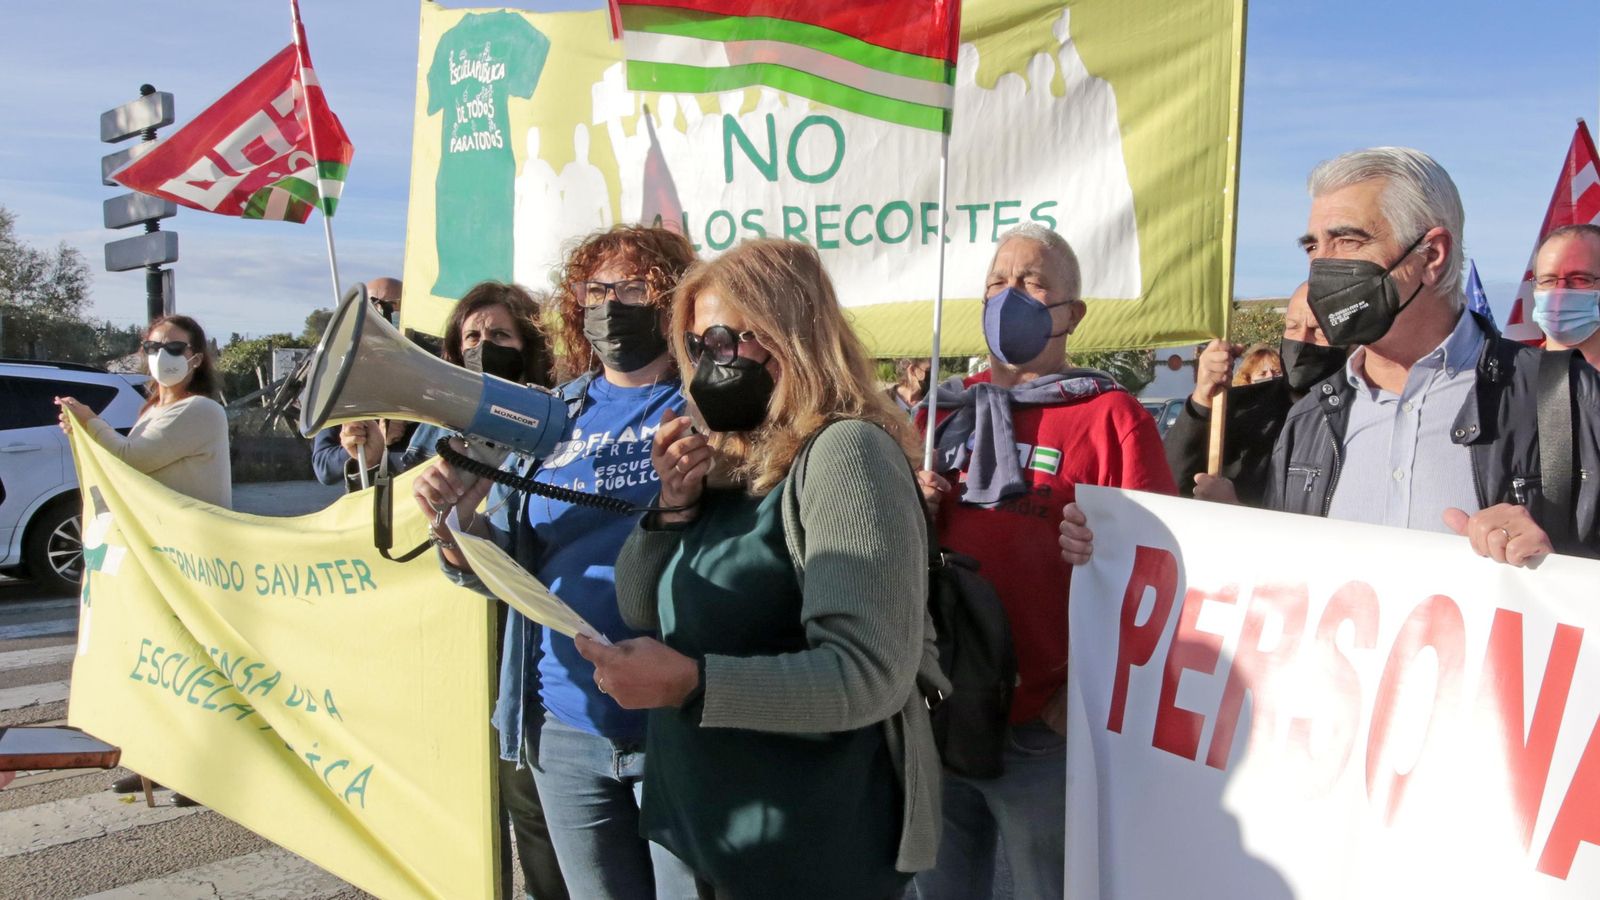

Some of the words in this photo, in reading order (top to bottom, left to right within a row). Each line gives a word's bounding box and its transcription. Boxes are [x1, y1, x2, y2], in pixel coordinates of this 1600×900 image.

[456, 106, 468, 124] DE
[450, 136, 475, 153] PARA
[722, 113, 846, 184] NO
[682, 208, 768, 252] LOS
[782, 200, 1058, 250] RECORTES
[582, 439, 652, 460] JEREZ
[254, 558, 378, 598] SAVATER
